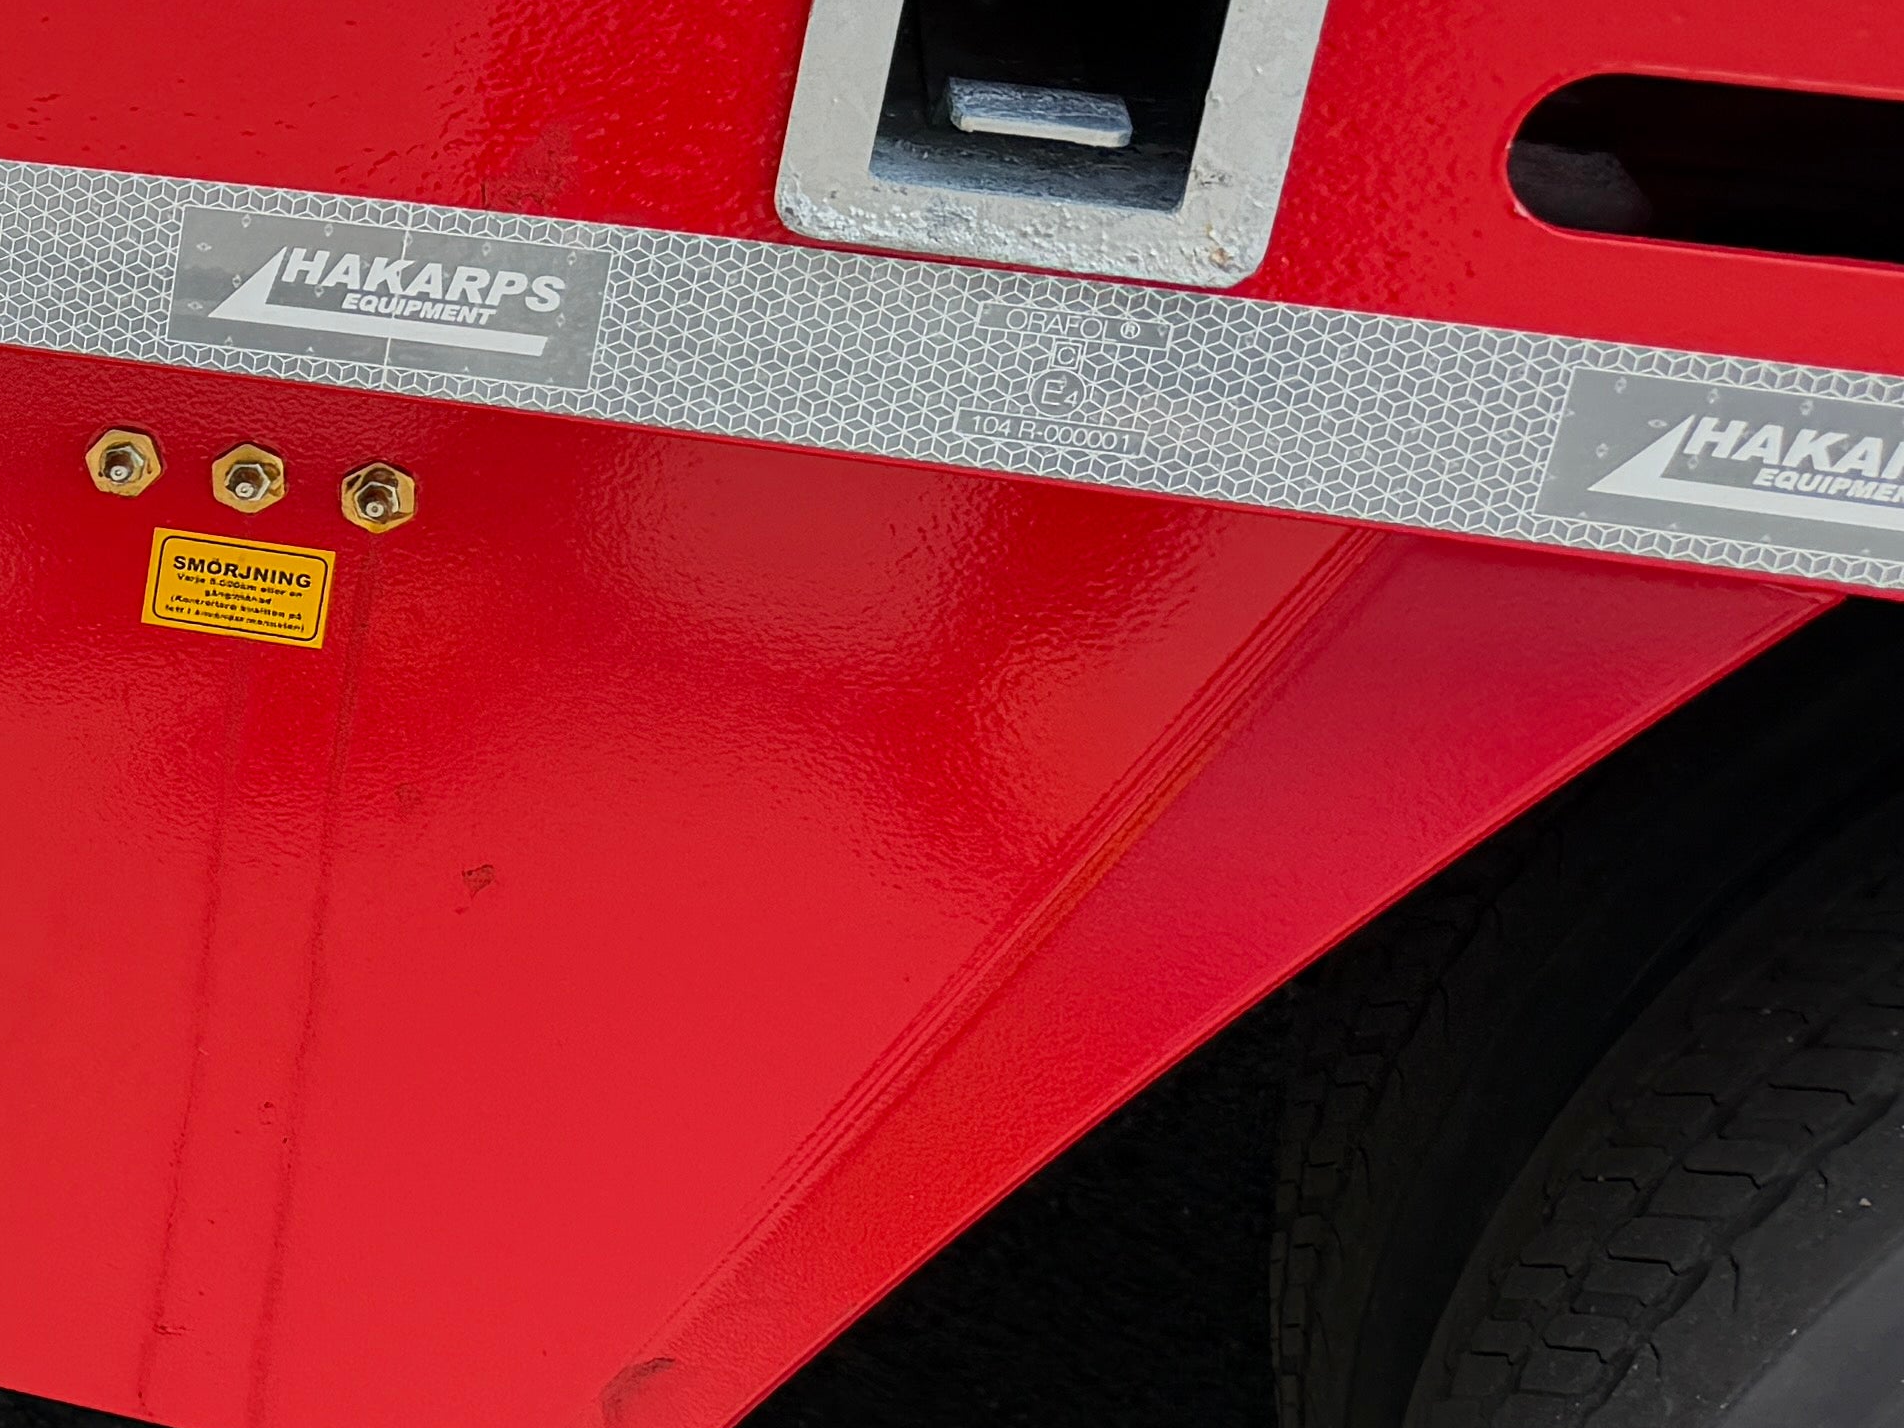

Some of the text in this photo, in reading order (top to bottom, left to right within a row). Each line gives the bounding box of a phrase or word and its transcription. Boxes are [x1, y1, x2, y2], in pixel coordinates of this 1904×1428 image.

[281, 247, 567, 313] HAKARPS
[341, 293, 497, 326] EQUIPMENT
[1056, 346, 1077, 365] C
[972, 414, 1012, 437] 104
[172, 554, 312, 589] SMÖRJNING
